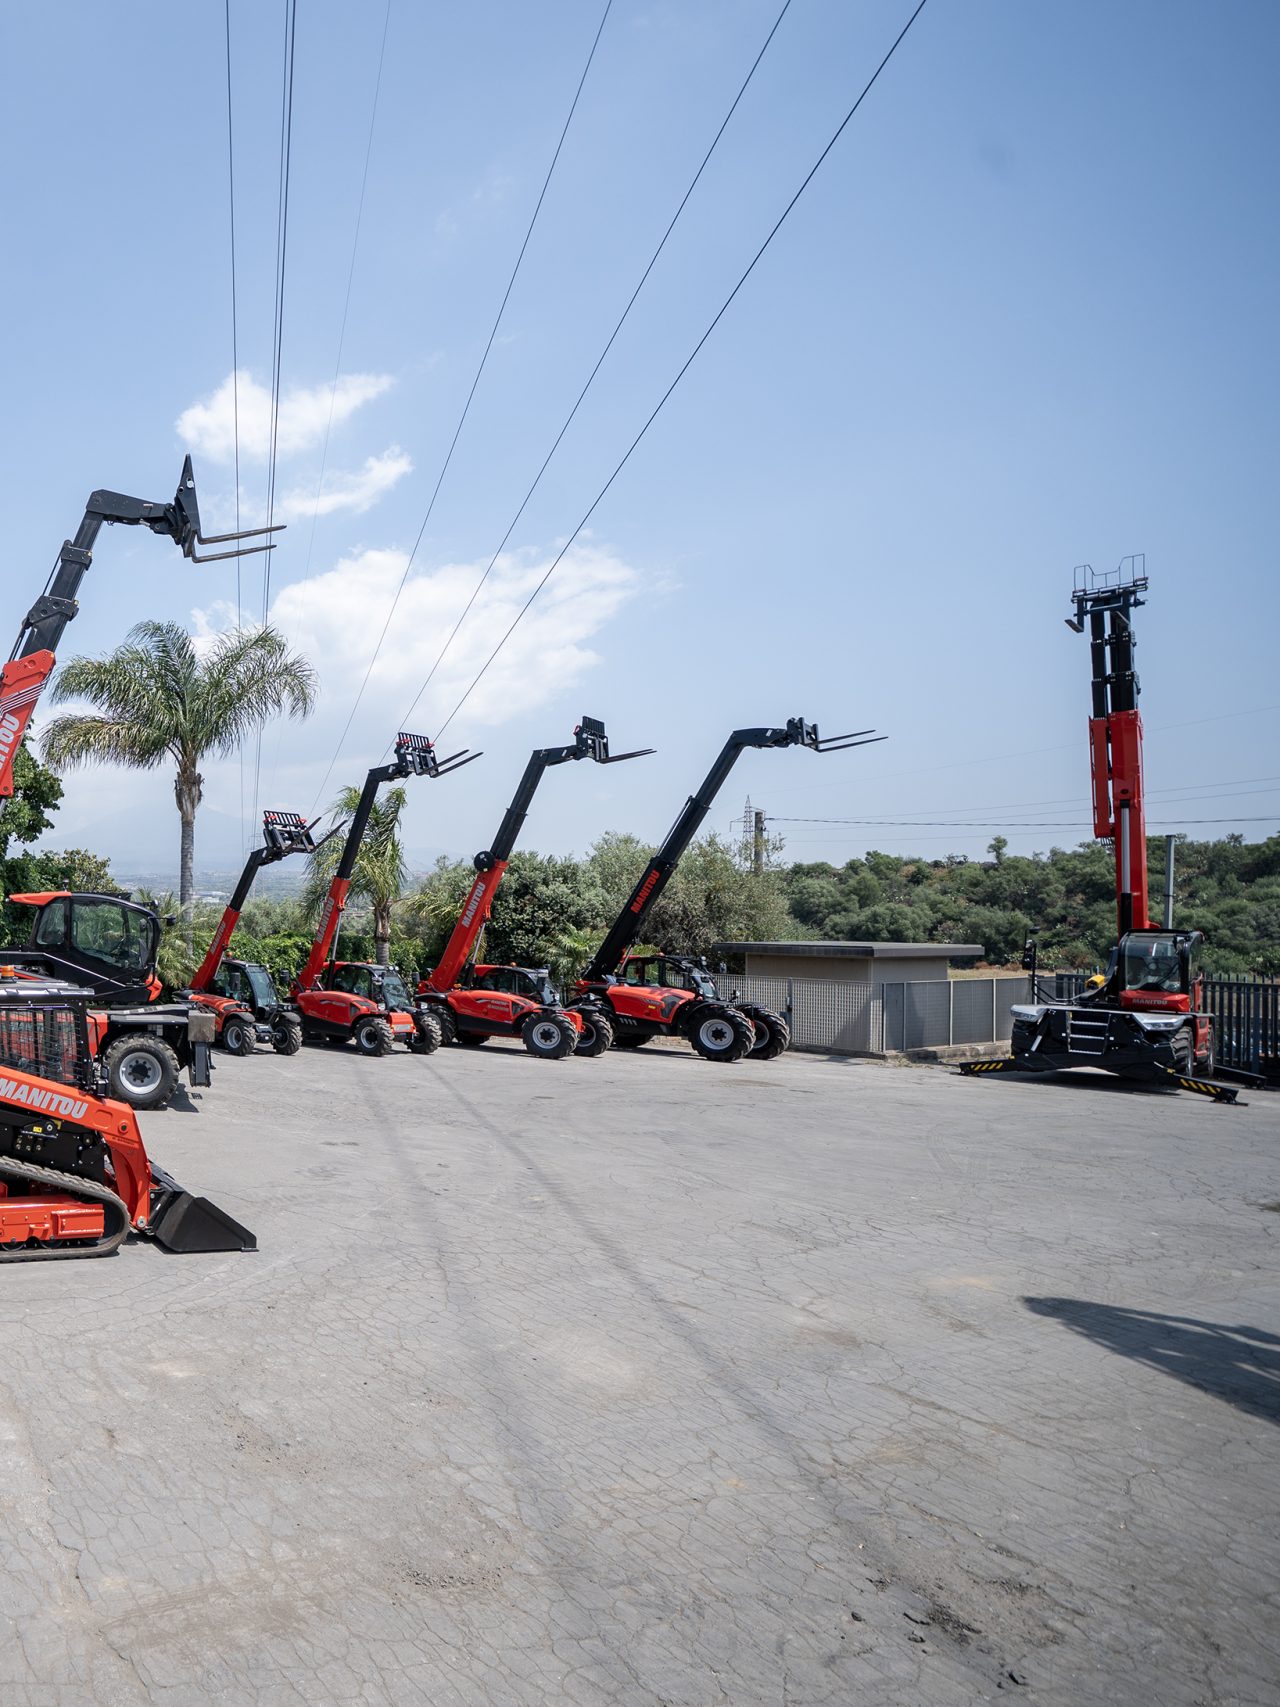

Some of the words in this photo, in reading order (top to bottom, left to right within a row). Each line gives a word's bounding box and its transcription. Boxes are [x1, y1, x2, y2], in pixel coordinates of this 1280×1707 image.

[462, 881, 486, 928] MANITOU
[630, 868, 660, 912] MANITOU
[315, 896, 335, 944] MANITOU
